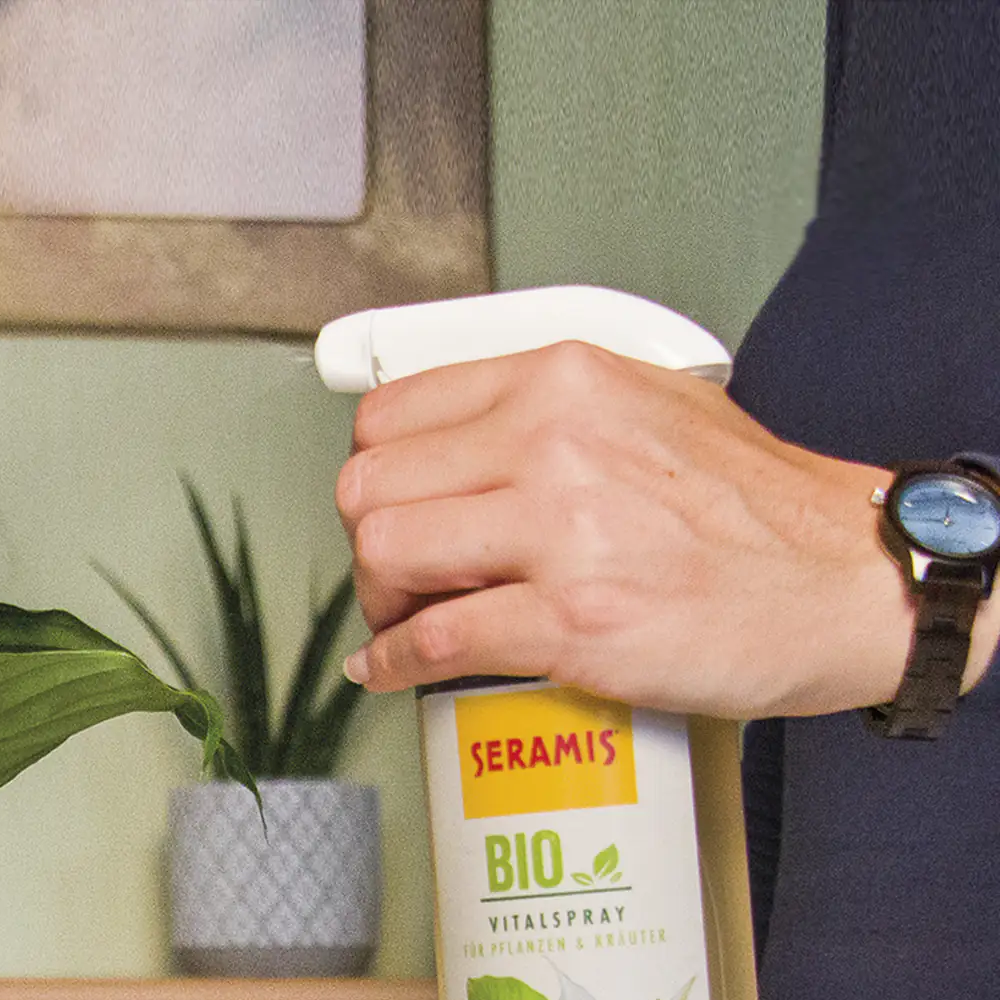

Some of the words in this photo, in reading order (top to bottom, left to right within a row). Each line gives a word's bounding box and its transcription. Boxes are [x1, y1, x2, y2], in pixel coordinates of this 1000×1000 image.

[471, 729, 616, 778] SERAMIS
[485, 829, 564, 893] BIO
[488, 906, 626, 933] VITALSPRAY
[463, 940, 484, 959] FÜR
[491, 937, 565, 956] PFLANZEN
[595, 927, 667, 949] KRÄUTER
